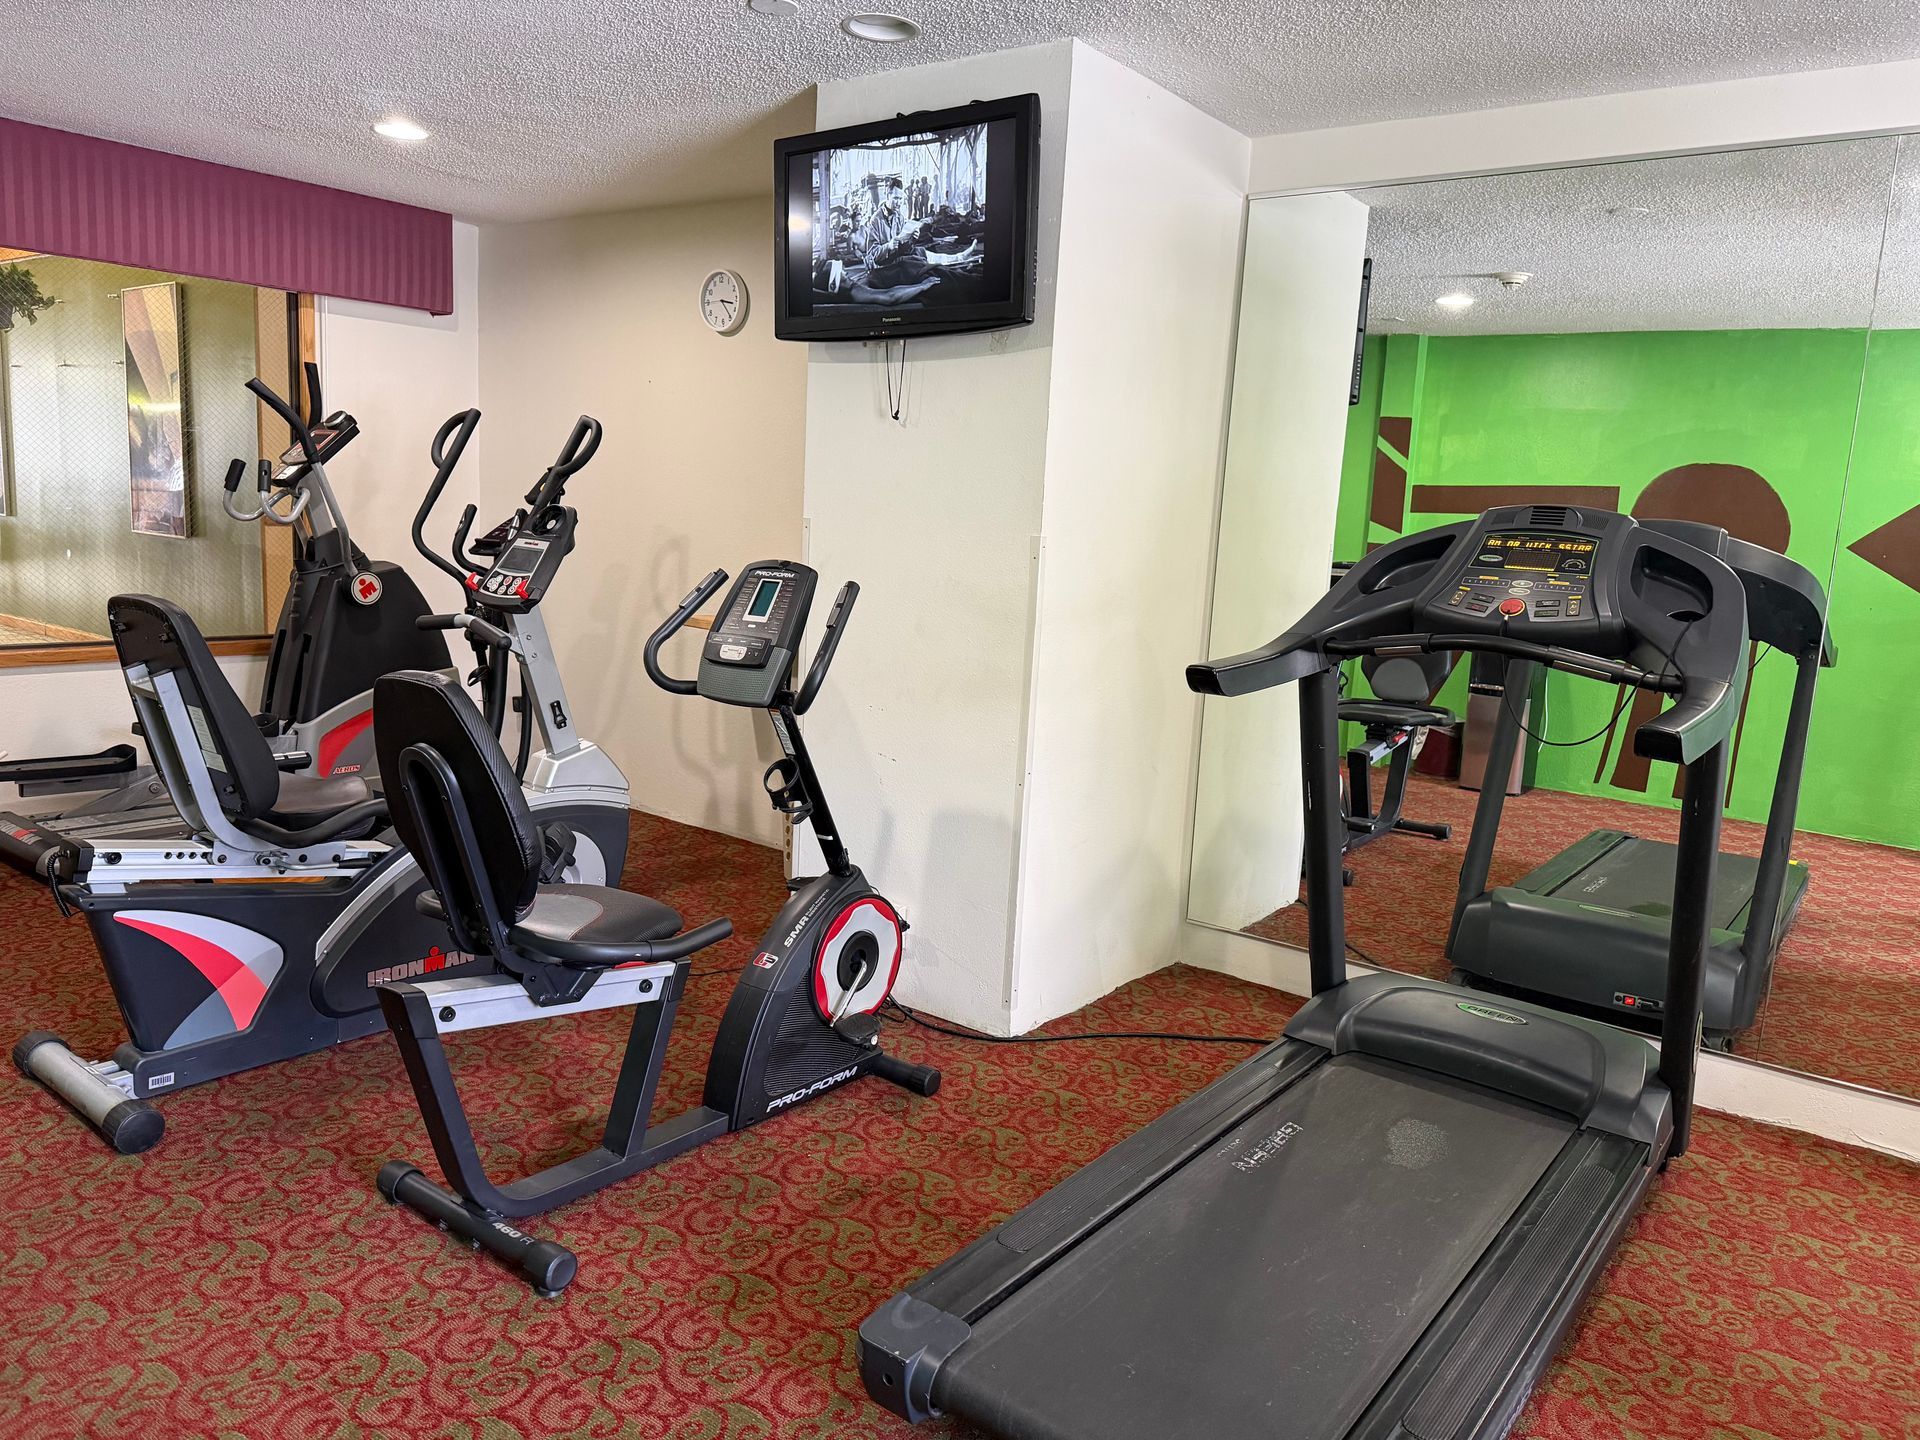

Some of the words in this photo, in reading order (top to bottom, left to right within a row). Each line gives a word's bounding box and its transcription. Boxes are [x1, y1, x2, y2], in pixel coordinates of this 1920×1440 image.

[783, 915, 810, 948] SMR
[367, 946, 475, 988] IRONMAN
[766, 1065, 858, 1113] PRO-FORM
[491, 1222, 522, 1238] 460
